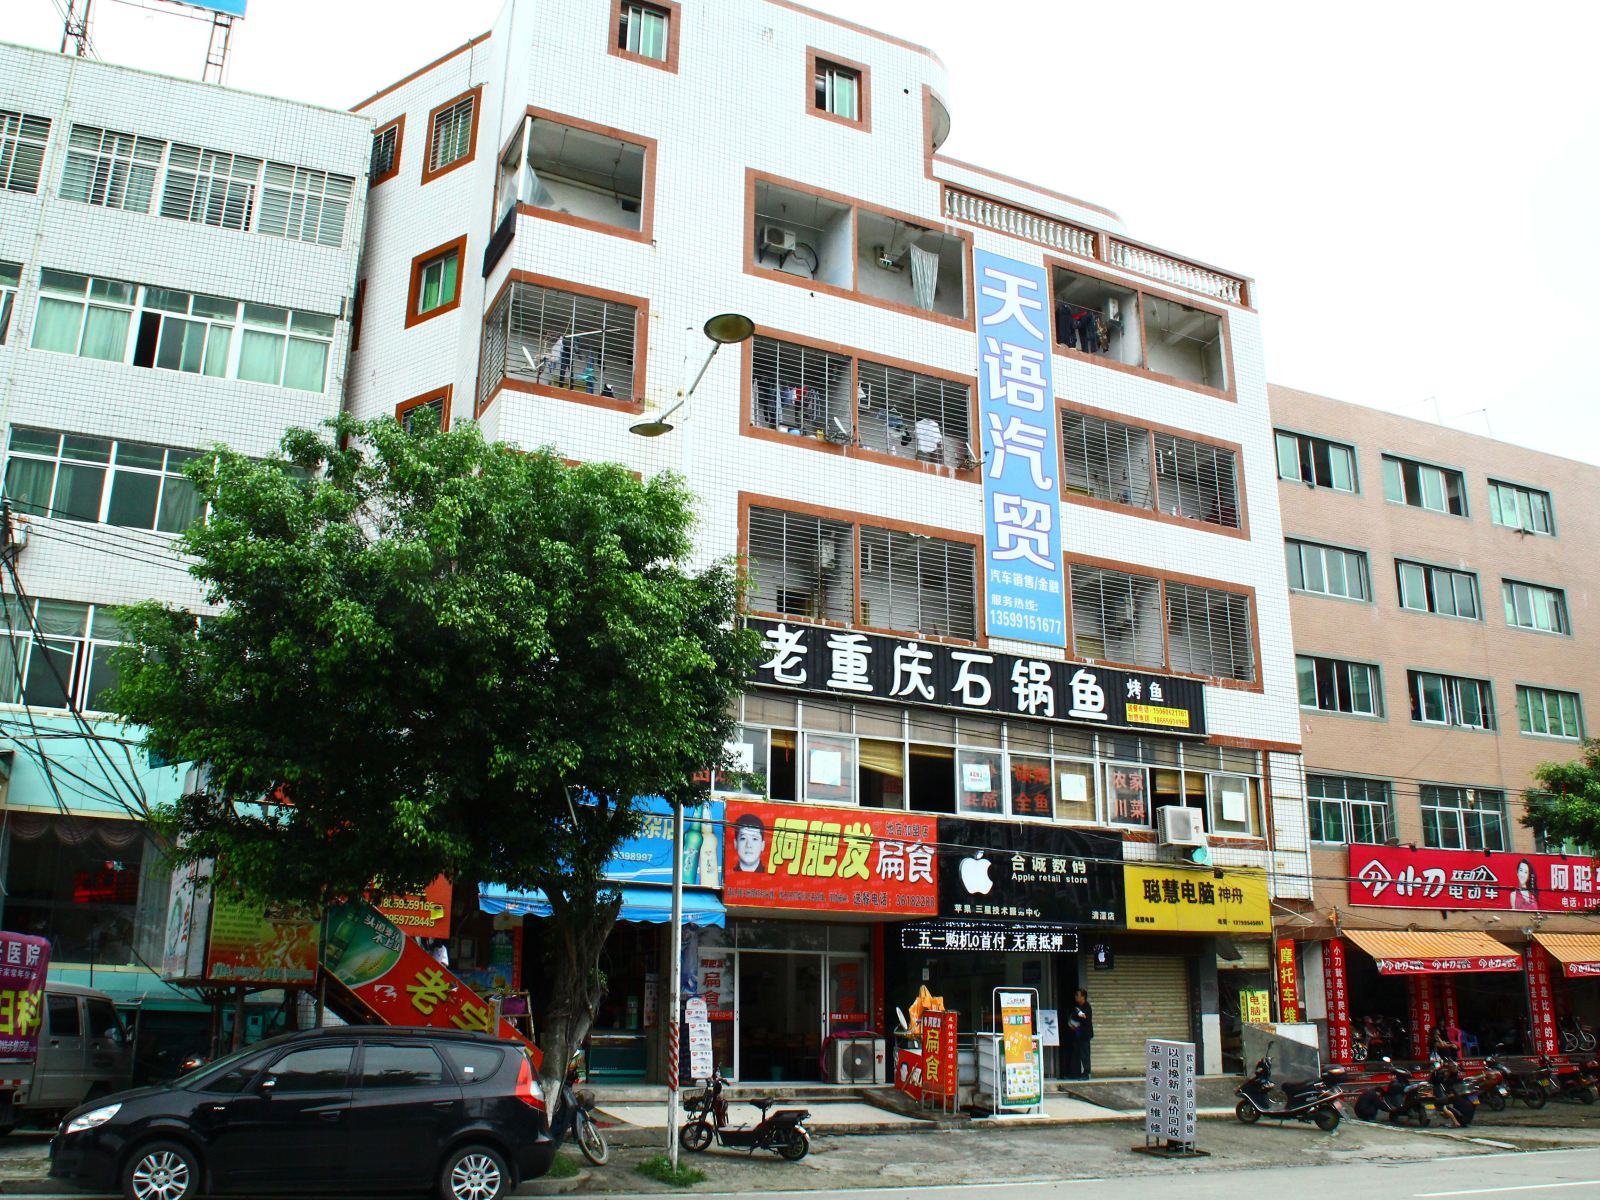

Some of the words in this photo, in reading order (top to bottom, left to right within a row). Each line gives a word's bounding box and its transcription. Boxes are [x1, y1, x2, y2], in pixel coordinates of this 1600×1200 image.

[981, 266, 1056, 571] 天语汽贸
[990, 569, 1060, 594] 汽车销售/金融
[990, 609, 1062, 635] 13599151677
[760, 623, 1109, 722] 老重庆石锅鱼
[1126, 678, 1164, 702] 烤鱼
[1113, 770, 1143, 791] 农家
[1014, 791, 1050, 812] 全鱼
[1114, 799, 1145, 819] 川菜
[768, 818, 874, 880] 阿肥发
[876, 840, 936, 884] 扁食
[1011, 854, 1087, 874] 合诚数码
[1011, 872, 1035, 883] Apple
[1039, 873, 1061, 883] retail
[1066, 876, 1088, 884] store
[1396, 865, 1447, 898] 小刀
[1451, 868, 1488, 882] 双动力
[1143, 879, 1215, 905] 聪慧电脑
[1218, 886, 1243, 904] 神舟
[1449, 884, 1500, 901] 电动车
[954, 904, 972, 915] 苹果
[0, 941, 41, 966] 医院
[1012, 934, 1064, 951] 无需抵押
[704, 971, 720, 1008] 扁食
[926, 1028, 940, 1082] 扁食
[1168, 1047, 1179, 1089] 以旧换新
[1168, 1094, 1179, 1138] 高价回收
